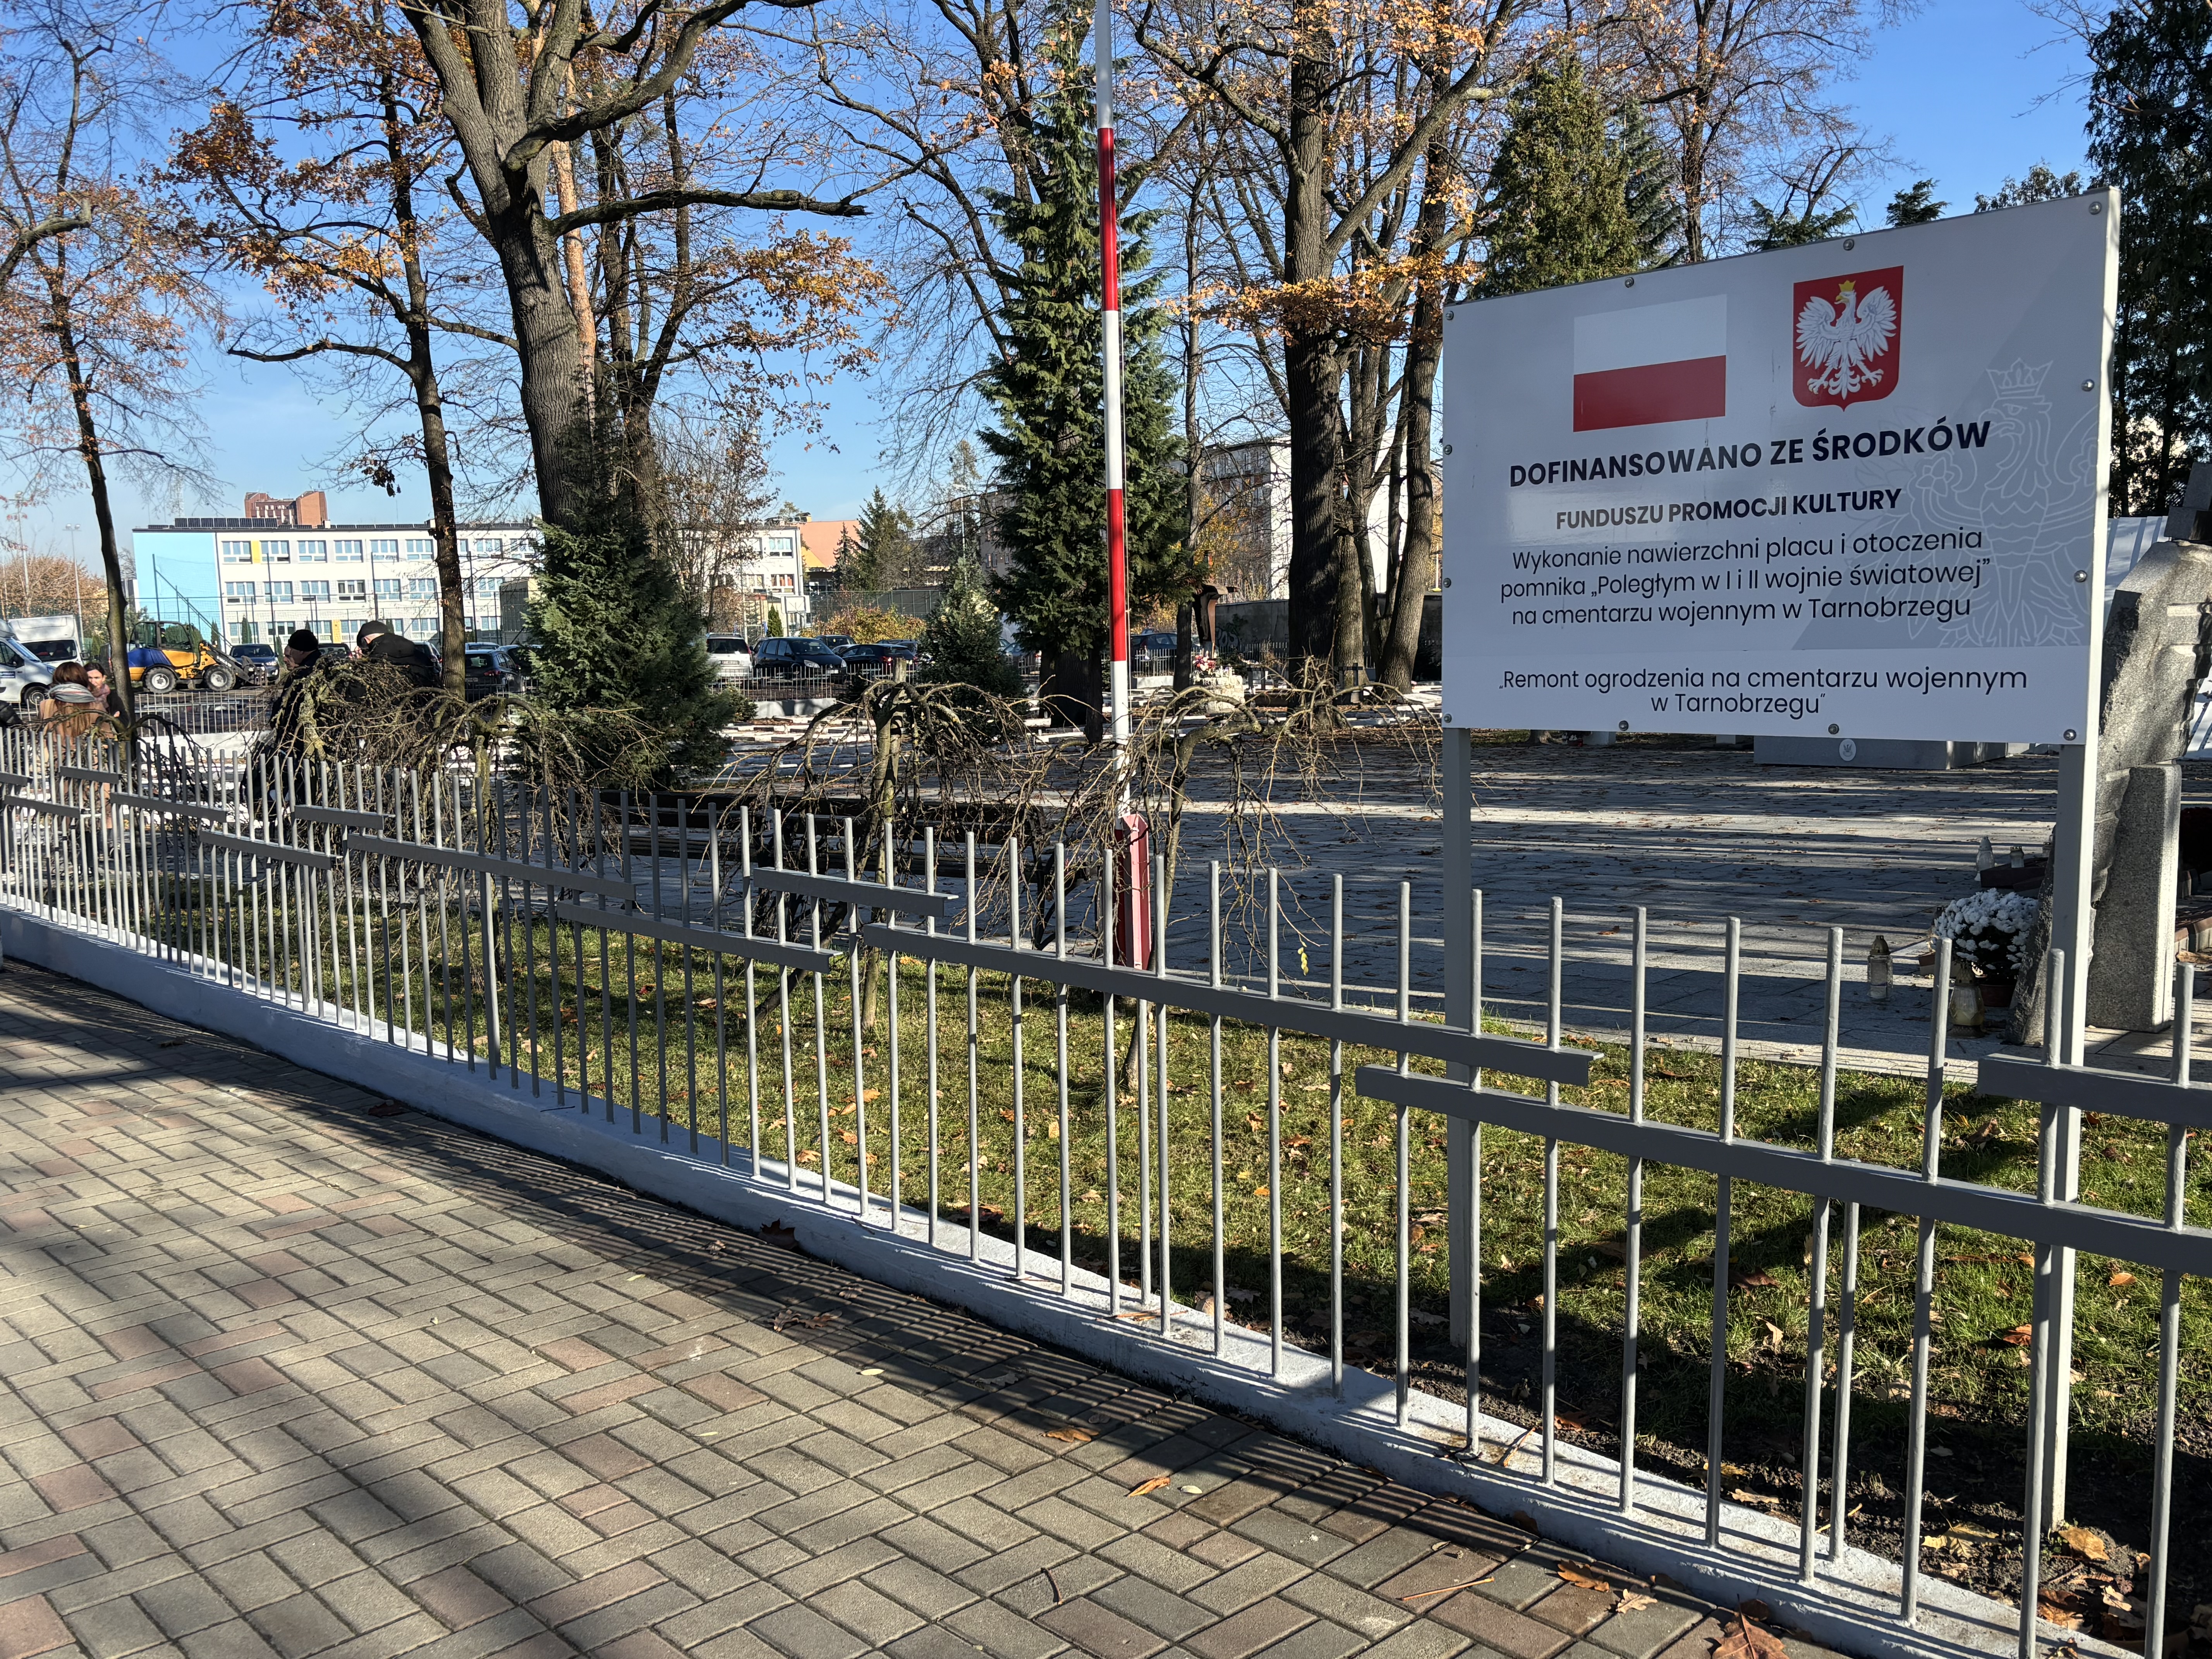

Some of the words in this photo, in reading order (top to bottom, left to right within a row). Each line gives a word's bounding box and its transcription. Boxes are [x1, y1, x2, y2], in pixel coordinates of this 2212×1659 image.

[1511, 443, 1761, 487] DOFINANSOWANO
[1771, 439, 1803, 465] ZE
[1813, 416, 1990, 461] ŚRODKÓW
[1557, 505, 1662, 529] FUNDUSZU
[1669, 496, 1786, 522] PROMOCJI
[1793, 489, 1901, 514] KULTURY
[1513, 546, 1621, 574] Wykonanie
[1628, 538, 1759, 563] nawierzchni
[1767, 537, 1832, 564] placu
[1841, 533, 1845, 554] i
[1853, 527, 1981, 553] otoczenia
[1501, 577, 1585, 603] pomnika
[1702, 575, 1720, 590] w
[1727, 570, 1730, 589] I
[1738, 569, 1741, 589] i
[1749, 570, 1758, 589] II
[1765, 566, 1842, 594] wojnie
[1513, 610, 1536, 624] na
[1543, 605, 1652, 624] cmentarzu
[1659, 601, 1775, 627] wojennym
[1783, 603, 1802, 618] w
[1808, 596, 1970, 623] Tarnobrzegu
[1585, 668, 1703, 693] ogrodzenia
[1712, 672, 1739, 687] na
[1748, 669, 1877, 687] cmentarzu
[1886, 666, 2026, 695] wojennym
[1651, 697, 1668, 711] w
